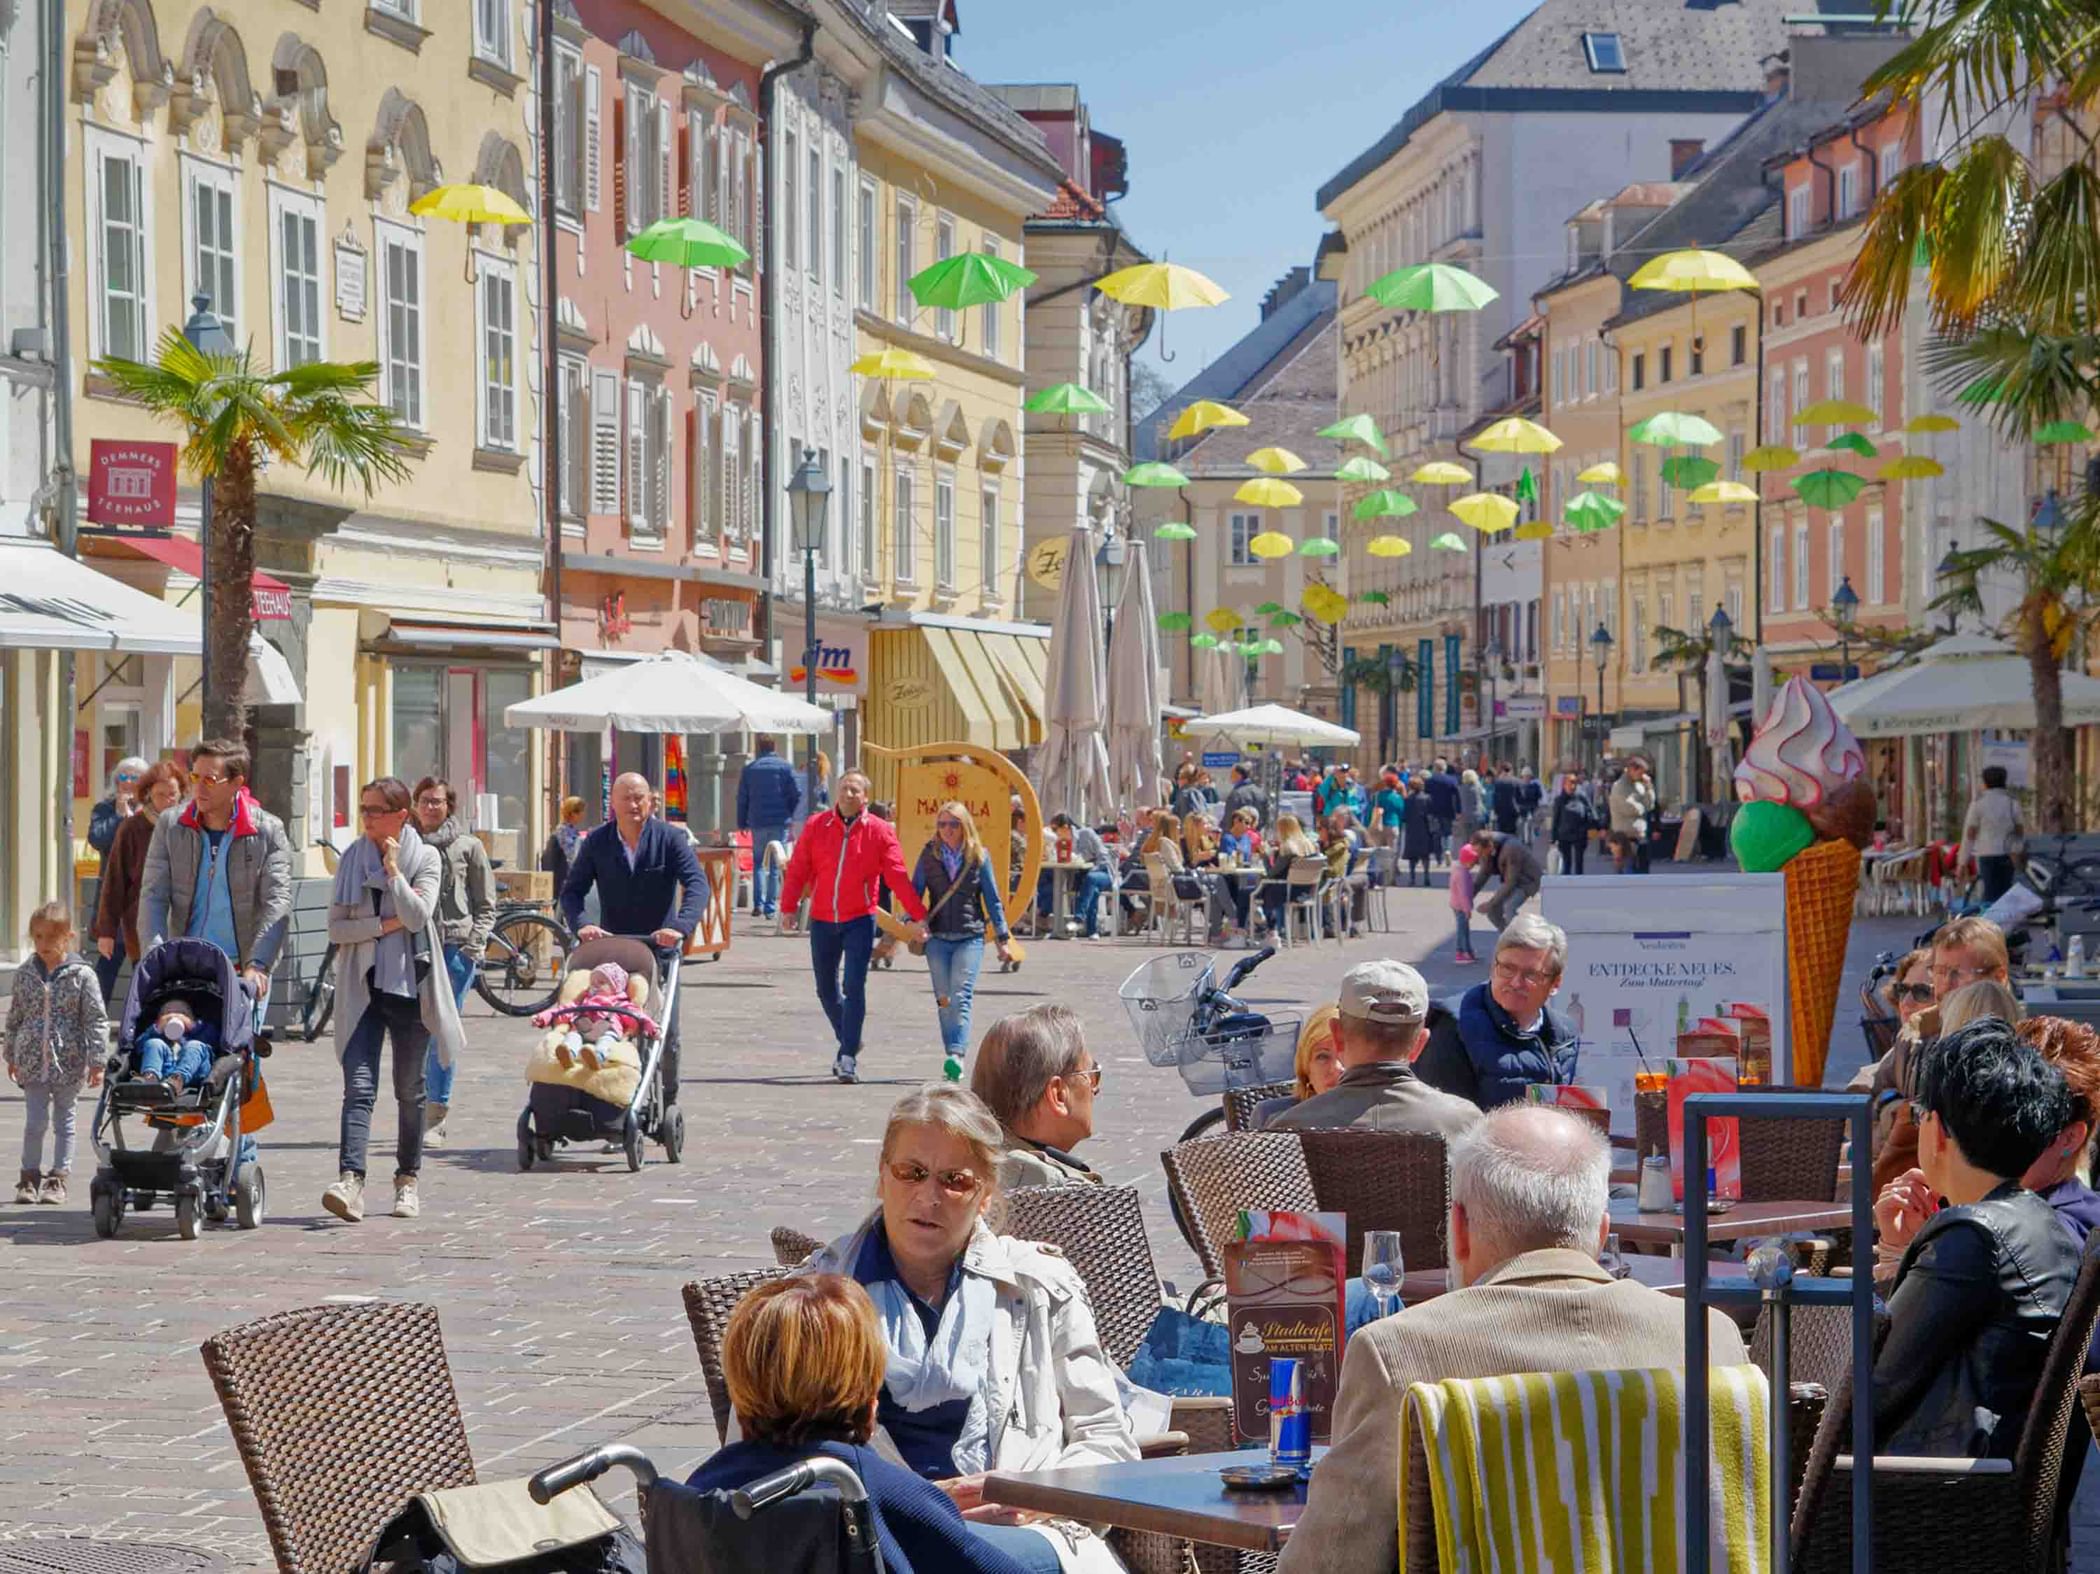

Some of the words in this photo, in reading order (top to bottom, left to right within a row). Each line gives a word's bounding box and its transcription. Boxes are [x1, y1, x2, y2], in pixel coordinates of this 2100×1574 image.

[100, 451, 161, 469] DEMMERS
[98, 497, 162, 514] TEEHAUS
[1589, 962, 1677, 976] ENTDECKE
[1680, 961, 1737, 975] NEUES.
[1619, 977, 1645, 988] Zum
[1264, 1344, 1278, 1353] AM
[1280, 1344, 1306, 1353] ALTEN
[1308, 1343, 1334, 1352] PLATZ
